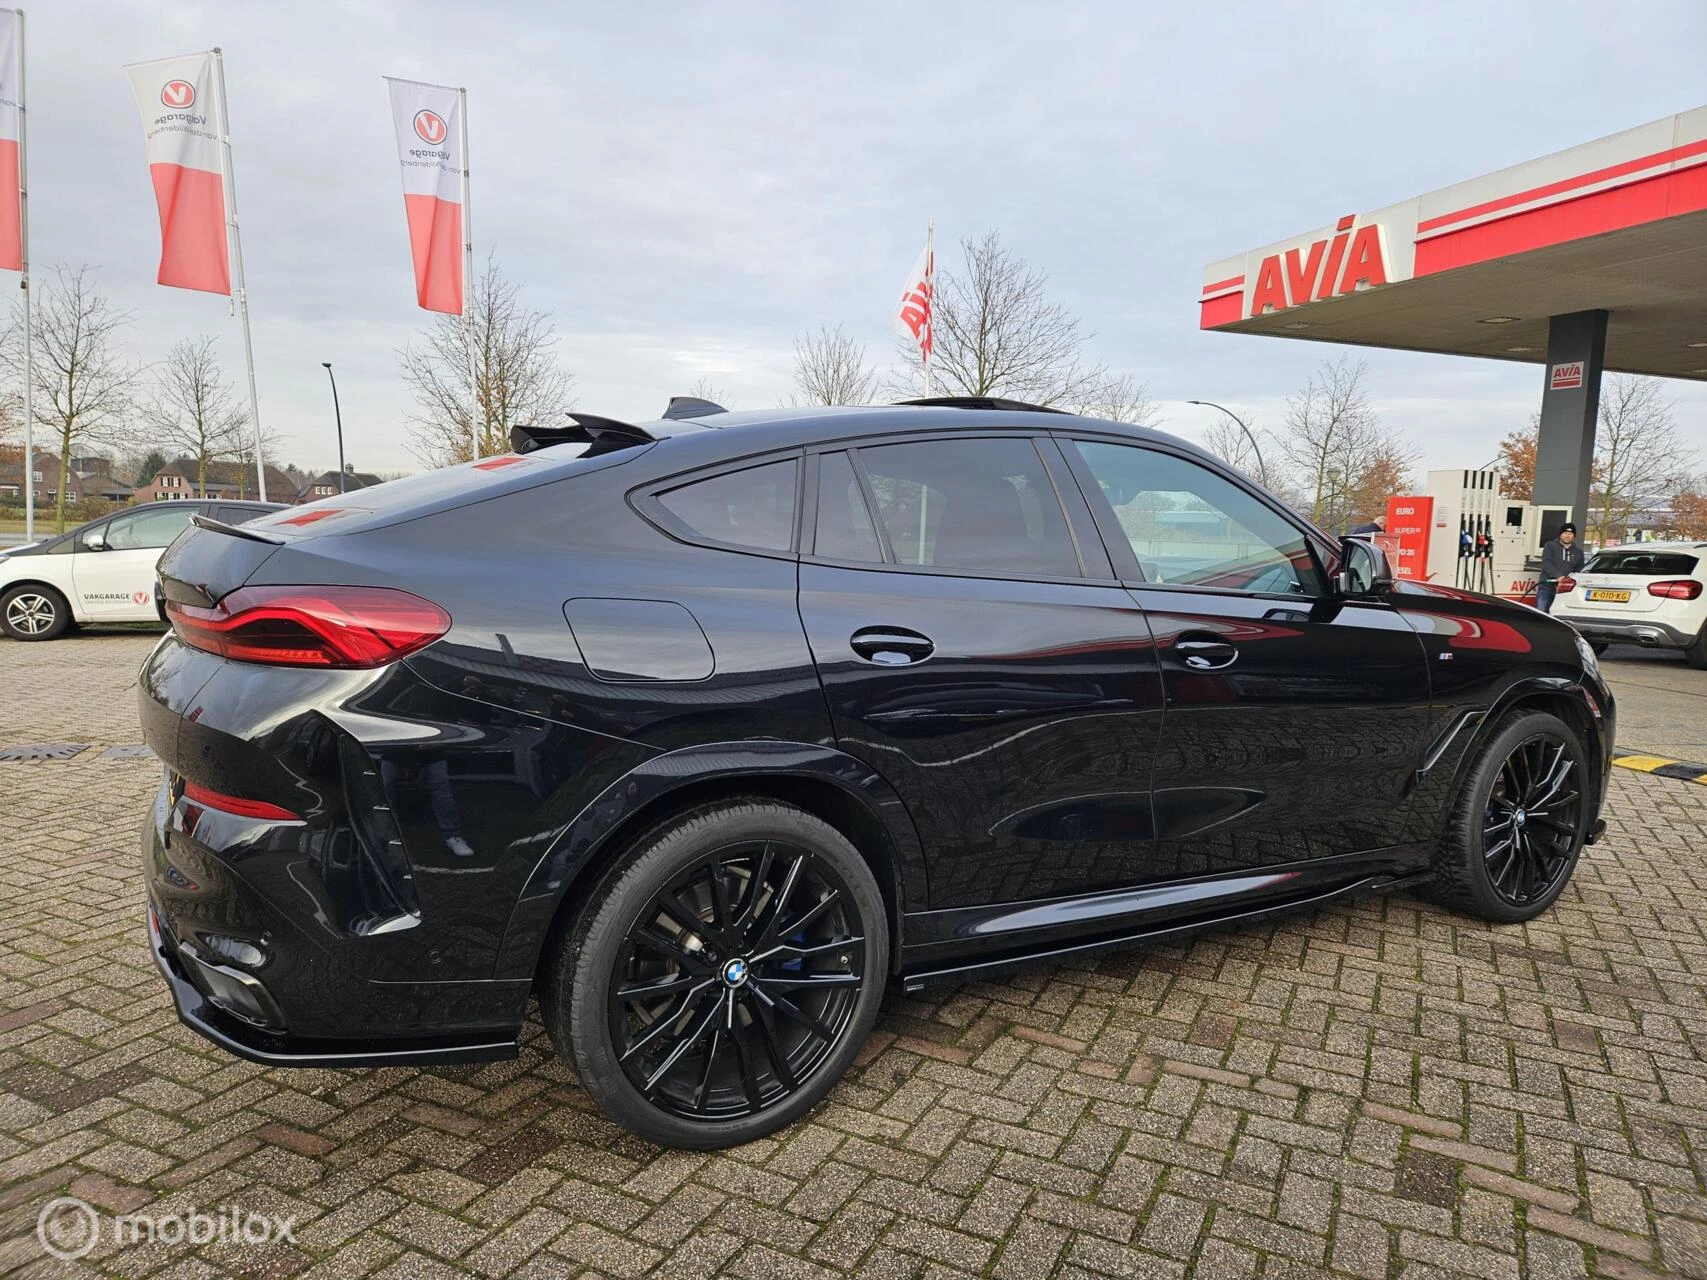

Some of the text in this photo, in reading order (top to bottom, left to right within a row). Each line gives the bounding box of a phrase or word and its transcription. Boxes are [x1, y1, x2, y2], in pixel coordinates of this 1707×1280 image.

[1250, 213, 1390, 317] AVIA
[1554, 364, 1581, 378] AVIA
[1395, 507, 1415, 516] EURO
[1516, 526, 1522, 535] 2
